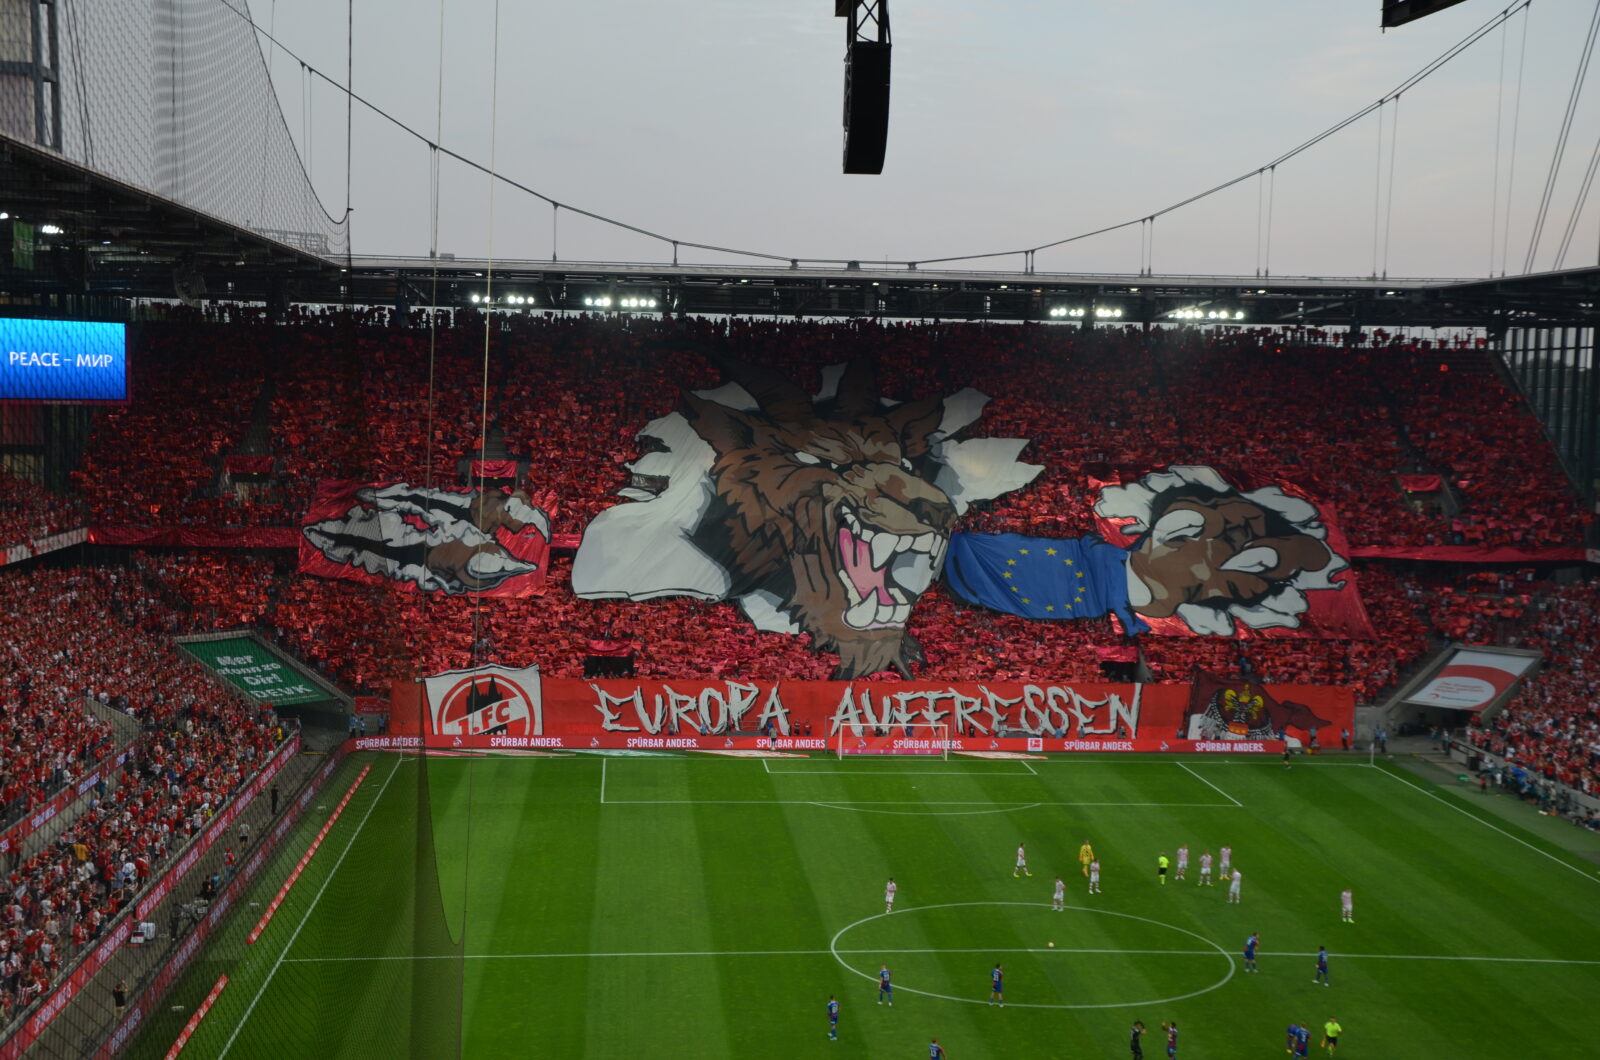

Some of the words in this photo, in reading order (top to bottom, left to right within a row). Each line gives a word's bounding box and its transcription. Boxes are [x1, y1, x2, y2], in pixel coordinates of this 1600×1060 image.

[9, 351, 60, 366] PEACE
[76, 353, 113, 367] МИР
[217, 655, 253, 666] Mer
[251, 685, 312, 698] DEVK
[590, 681, 791, 736] EUROPA
[829, 682, 1142, 739] AUFFRESSEN
[355, 737, 390, 749] SPÜRBAR
[490, 736, 528, 747] SPÜRBAR
[530, 738, 564, 747] ANDERS.
[627, 737, 664, 748] SPÜRBAR
[666, 739, 699, 748] ANDERS.
[893, 738, 930, 749] SPÜRBAR
[1064, 740, 1100, 750] SPÜRBAR
[1102, 742, 1134, 751] ANDERS.
[1195, 741, 1231, 752] SPÜRBAR
[1233, 743, 1266, 752] ANDERS.
